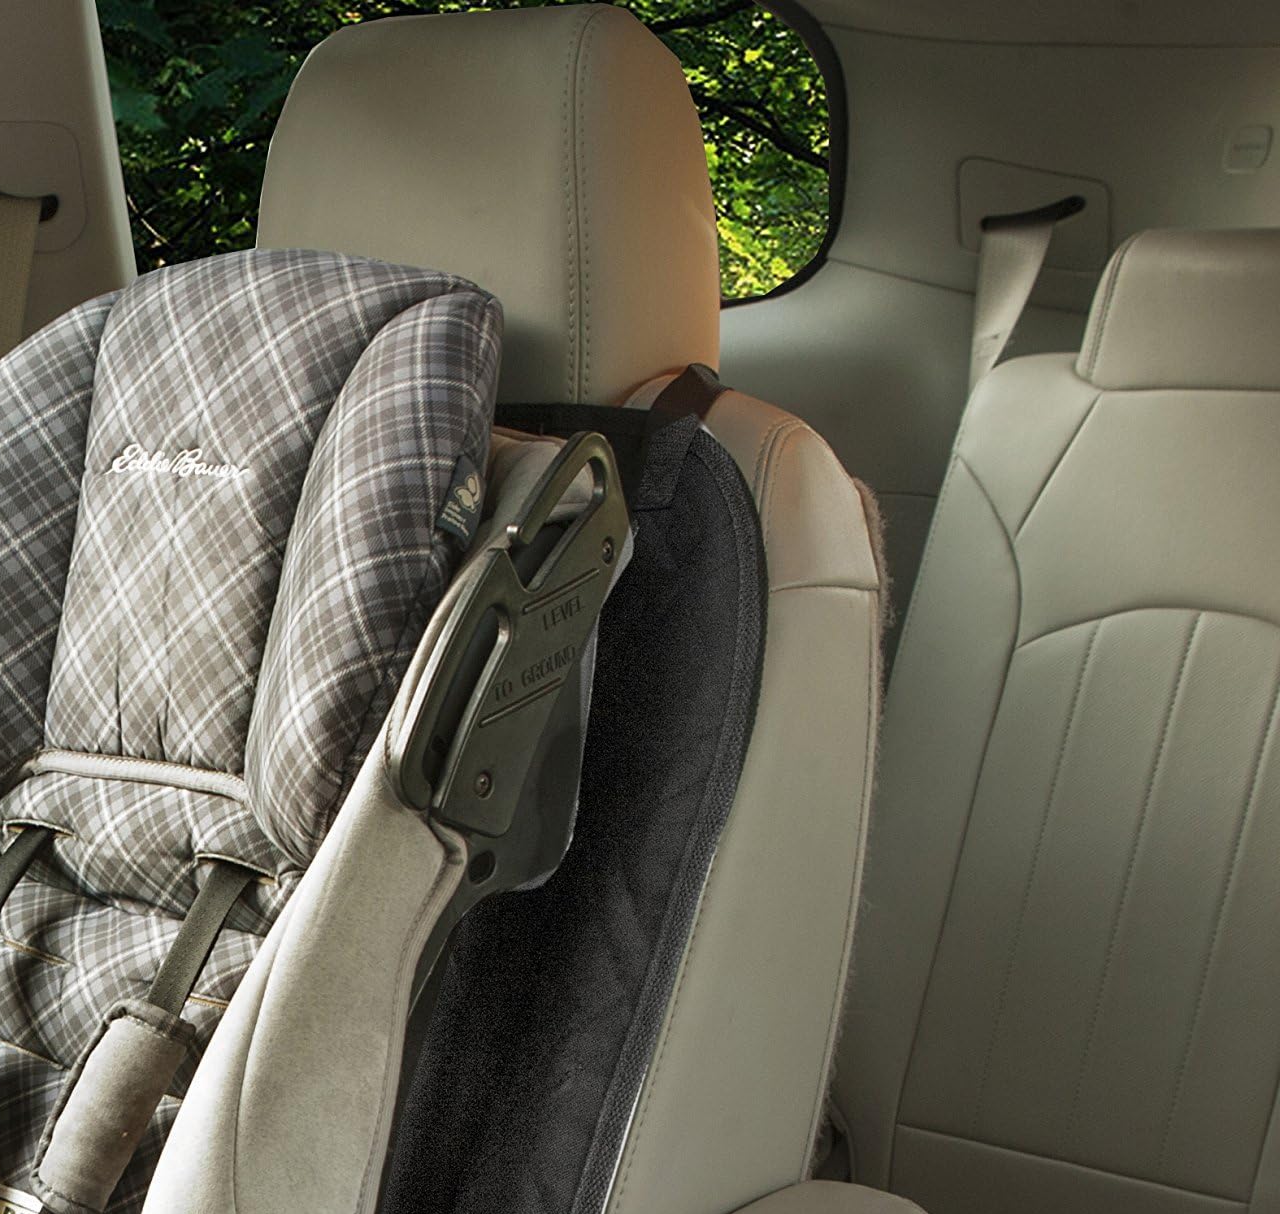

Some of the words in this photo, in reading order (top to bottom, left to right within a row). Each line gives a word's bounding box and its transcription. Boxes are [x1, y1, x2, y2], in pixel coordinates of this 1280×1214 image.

[102, 443, 171, 474] Eddie
[171, 448, 249, 478] Bauer
[542, 595, 586, 631] LEVEL
[492, 678, 513, 702] TO
[521, 644, 577, 688] GROUND
